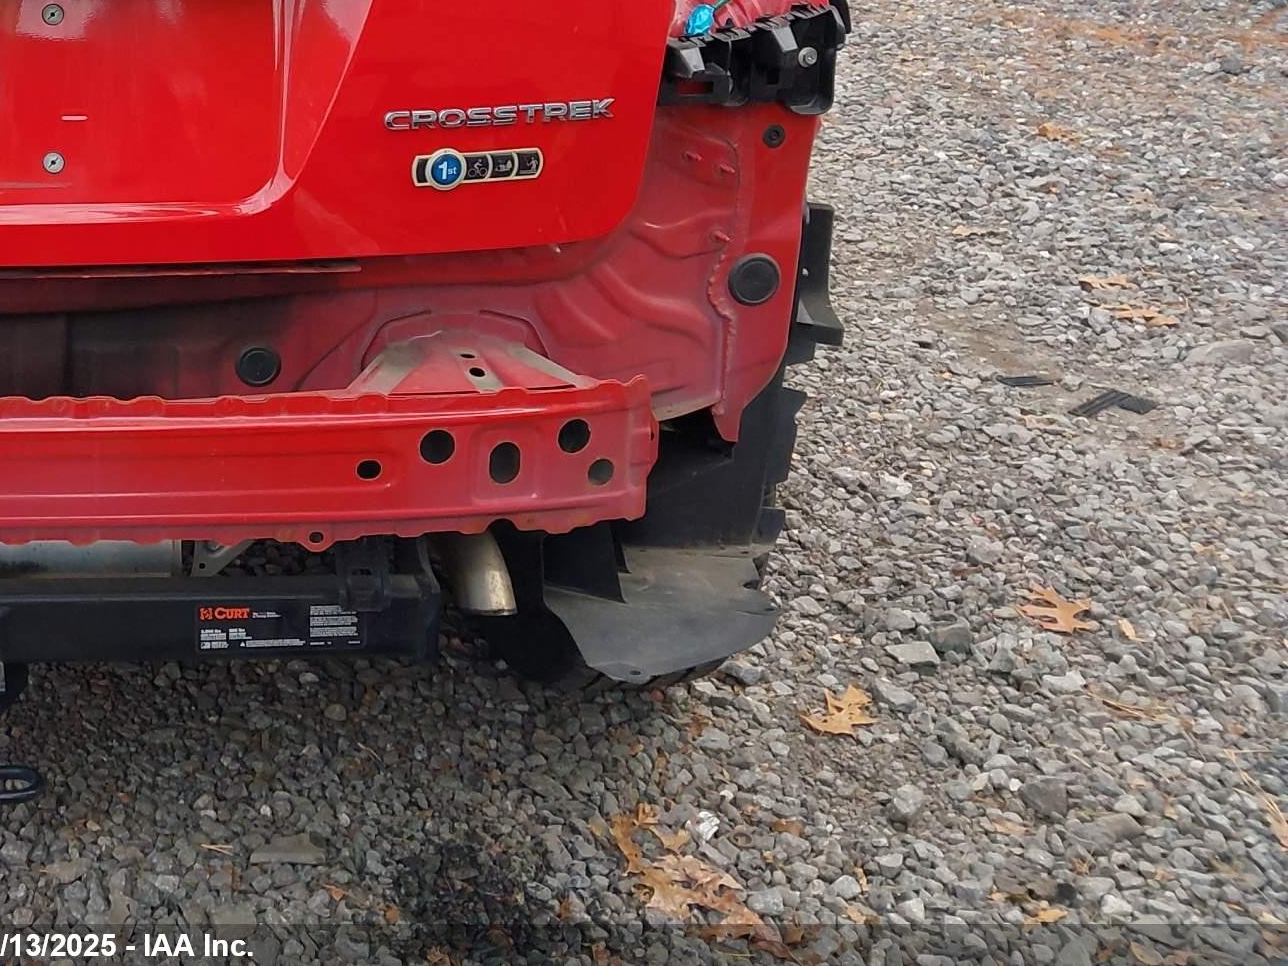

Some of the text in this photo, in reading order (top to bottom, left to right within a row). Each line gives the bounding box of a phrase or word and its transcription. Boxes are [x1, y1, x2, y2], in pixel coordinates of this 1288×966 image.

[384, 98, 616, 130] CROSSTREK
[438, 161, 458, 180] 1st
[214, 607, 250, 620] CURT
